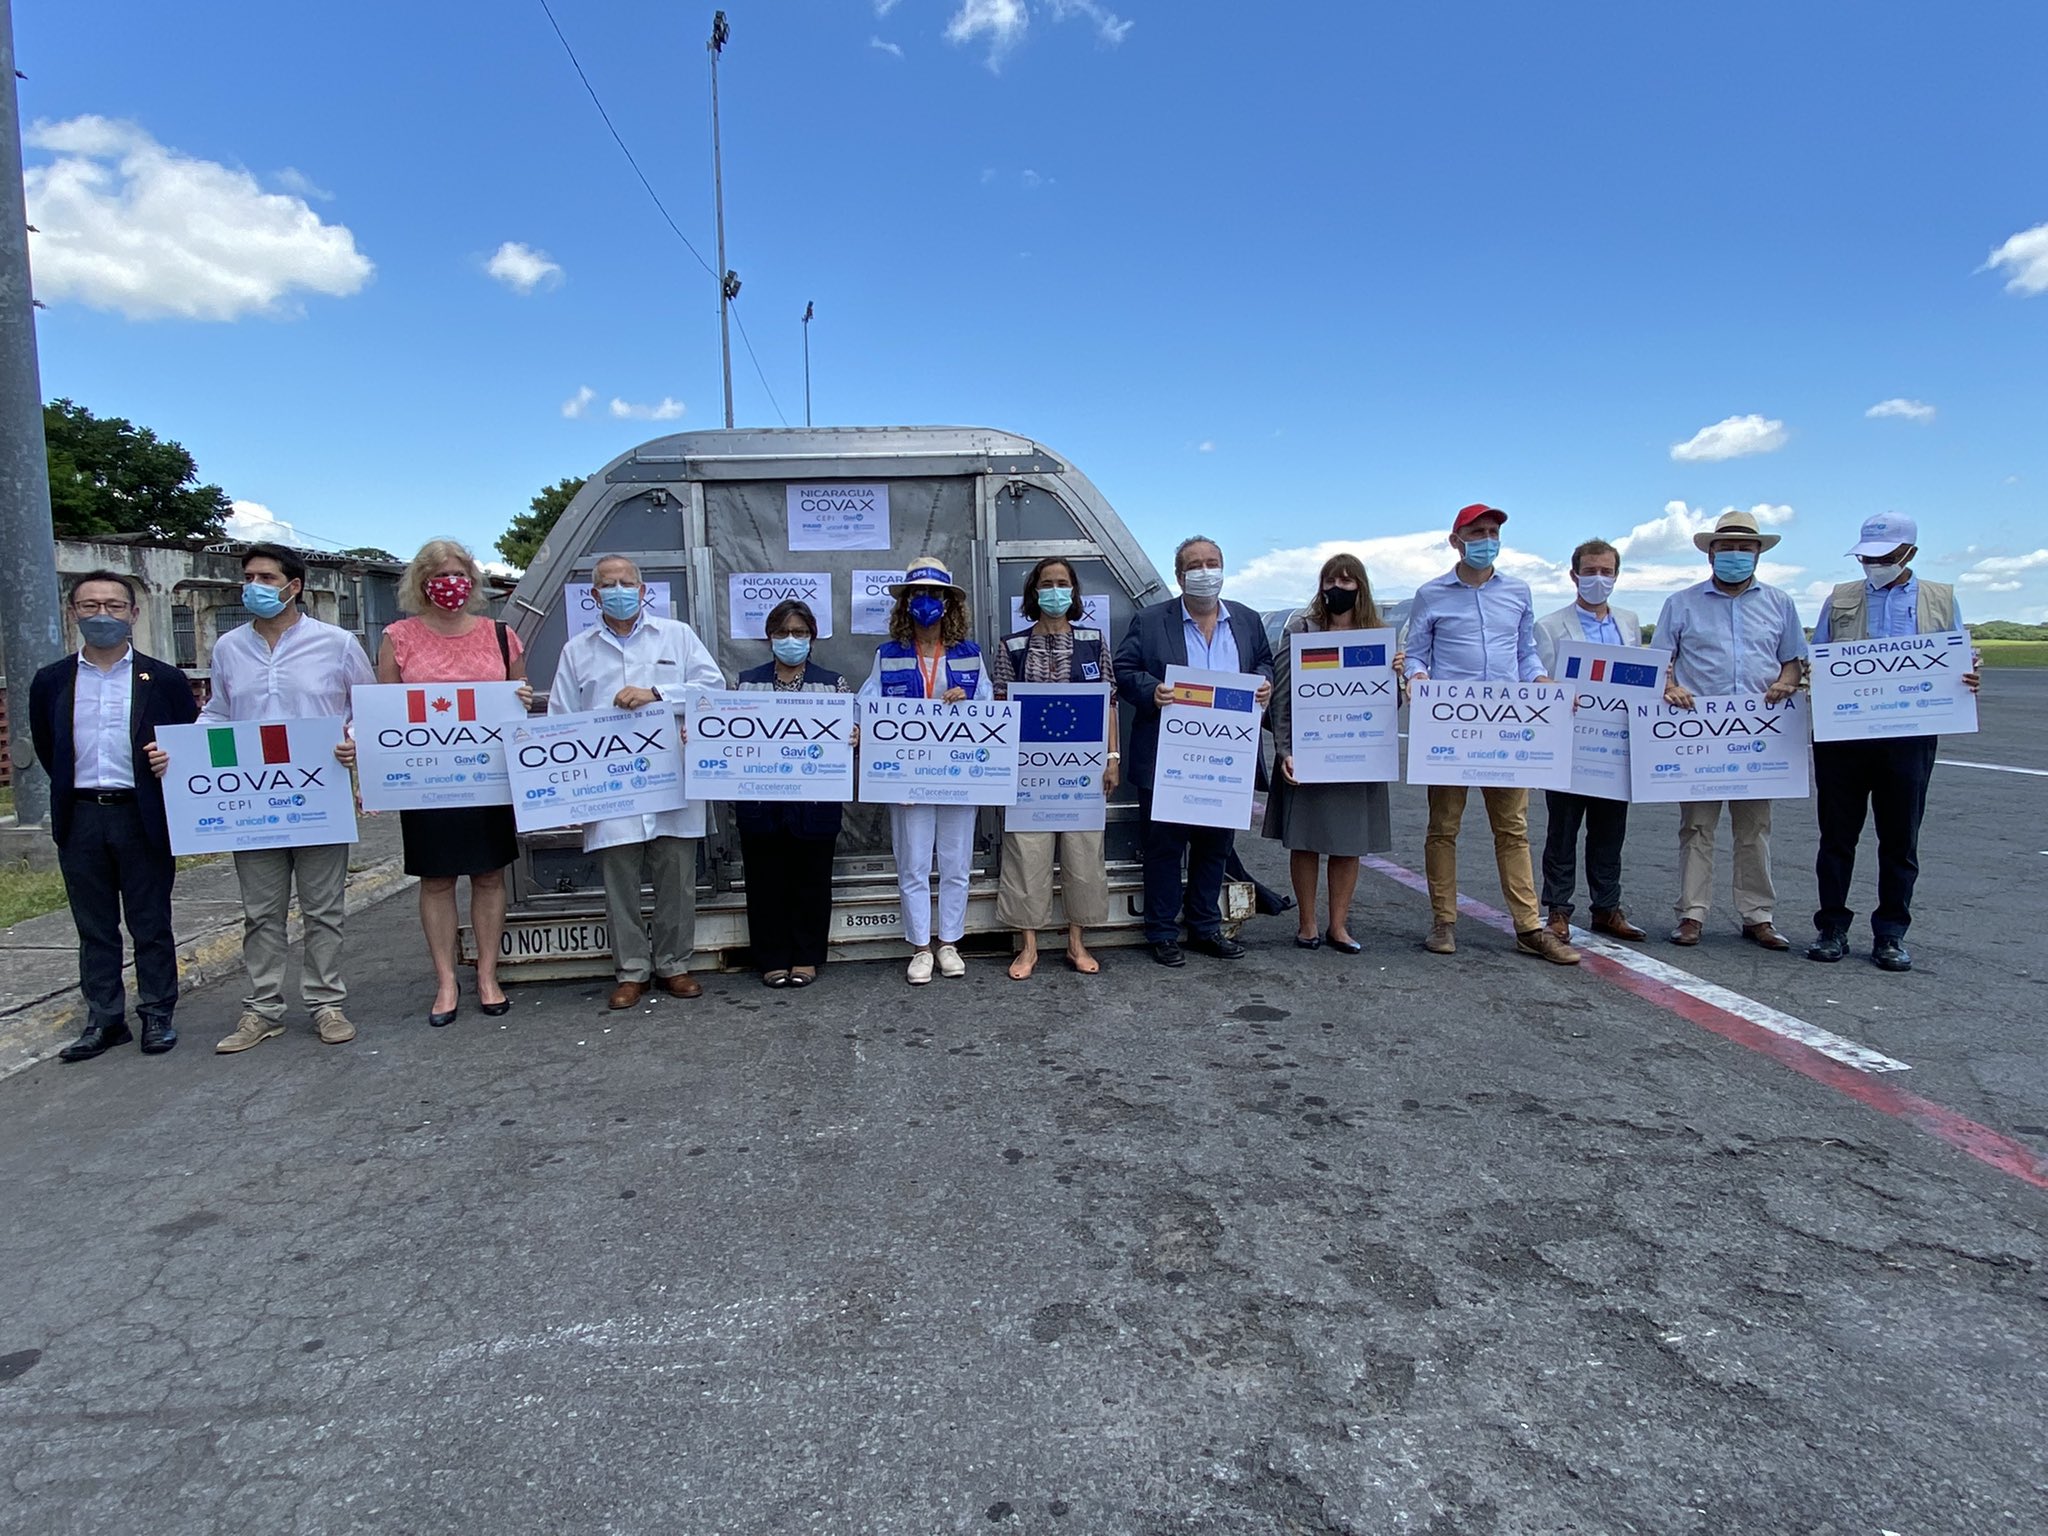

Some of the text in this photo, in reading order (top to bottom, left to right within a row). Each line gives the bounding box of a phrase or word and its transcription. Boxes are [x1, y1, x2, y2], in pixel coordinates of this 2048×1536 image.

[801, 490, 874, 498] NICARAGUA
[801, 499, 874, 512] COVAX
[743, 578, 817, 586] NICARAGUA
[866, 575, 904, 583] NICAR
[744, 588, 817, 599] COVAX
[1842, 639, 1934, 656] NICARAGUA
[1830, 652, 1949, 677] COVAX
[1298, 680, 1390, 698] COVAX
[1420, 685, 1564, 700] NICARAGUA
[1854, 688, 1883, 697] CEPI
[1898, 684, 1919, 693] Gavi
[1578, 694, 1629, 714] OVA
[1638, 698, 1795, 717] NICARAGUA
[1837, 702, 1859, 711] OPS
[1870, 701, 1899, 711] unicef
[869, 702, 1012, 718] NICARAGUA
[1432, 703, 1550, 724] COVAX
[1319, 714, 1342, 722] CEPI
[698, 716, 841, 740] COVAX
[873, 720, 1007, 744] COVAX
[1166, 719, 1254, 742] COVAX
[1574, 726, 1598, 735] CEPI
[1653, 716, 1782, 739] COVAX
[378, 726, 503, 748] COVAX
[1451, 729, 1482, 739] CEPI
[1499, 730, 1520, 739] Gavi
[519, 729, 666, 768] COVAX
[723, 746, 761, 757] CEPI
[781, 746, 806, 757] Gavi
[1431, 746, 1455, 755] OPS
[1676, 745, 1709, 755] CEPI
[1727, 743, 1750, 752] Gavi
[454, 755, 476, 764] Gavi
[896, 749, 931, 760] CEPI
[950, 750, 974, 760] Gavi
[1018, 752, 1102, 766] COVAX
[1183, 753, 1205, 762] CEPI
[1467, 750, 1497, 759] unicef
[406, 758, 438, 767] CEPI
[607, 761, 634, 774] Gavi
[698, 759, 728, 769] OPS
[744, 762, 778, 774] unicef
[873, 761, 900, 771] OPS
[1655, 764, 1681, 772] OPS
[915, 765, 947, 776] unicef
[1695, 764, 1726, 774] unicef
[188, 767, 324, 794] COVAX
[424, 774, 454, 784] unicef
[549, 769, 588, 784] CEPI
[1058, 777, 1078, 786] Gavi
[1021, 778, 1050, 787] CEPI
[526, 786, 556, 799] OPS
[572, 781, 608, 797] unicef
[218, 800, 252, 811] CEPI
[268, 797, 291, 806] Gavi
[199, 817, 224, 826] OPS
[236, 816, 266, 826] unicef
[847, 913, 896, 926] 830863
[501, 931, 512, 955] O
[518, 928, 551, 954] NOT
[558, 926, 589, 952] USE
